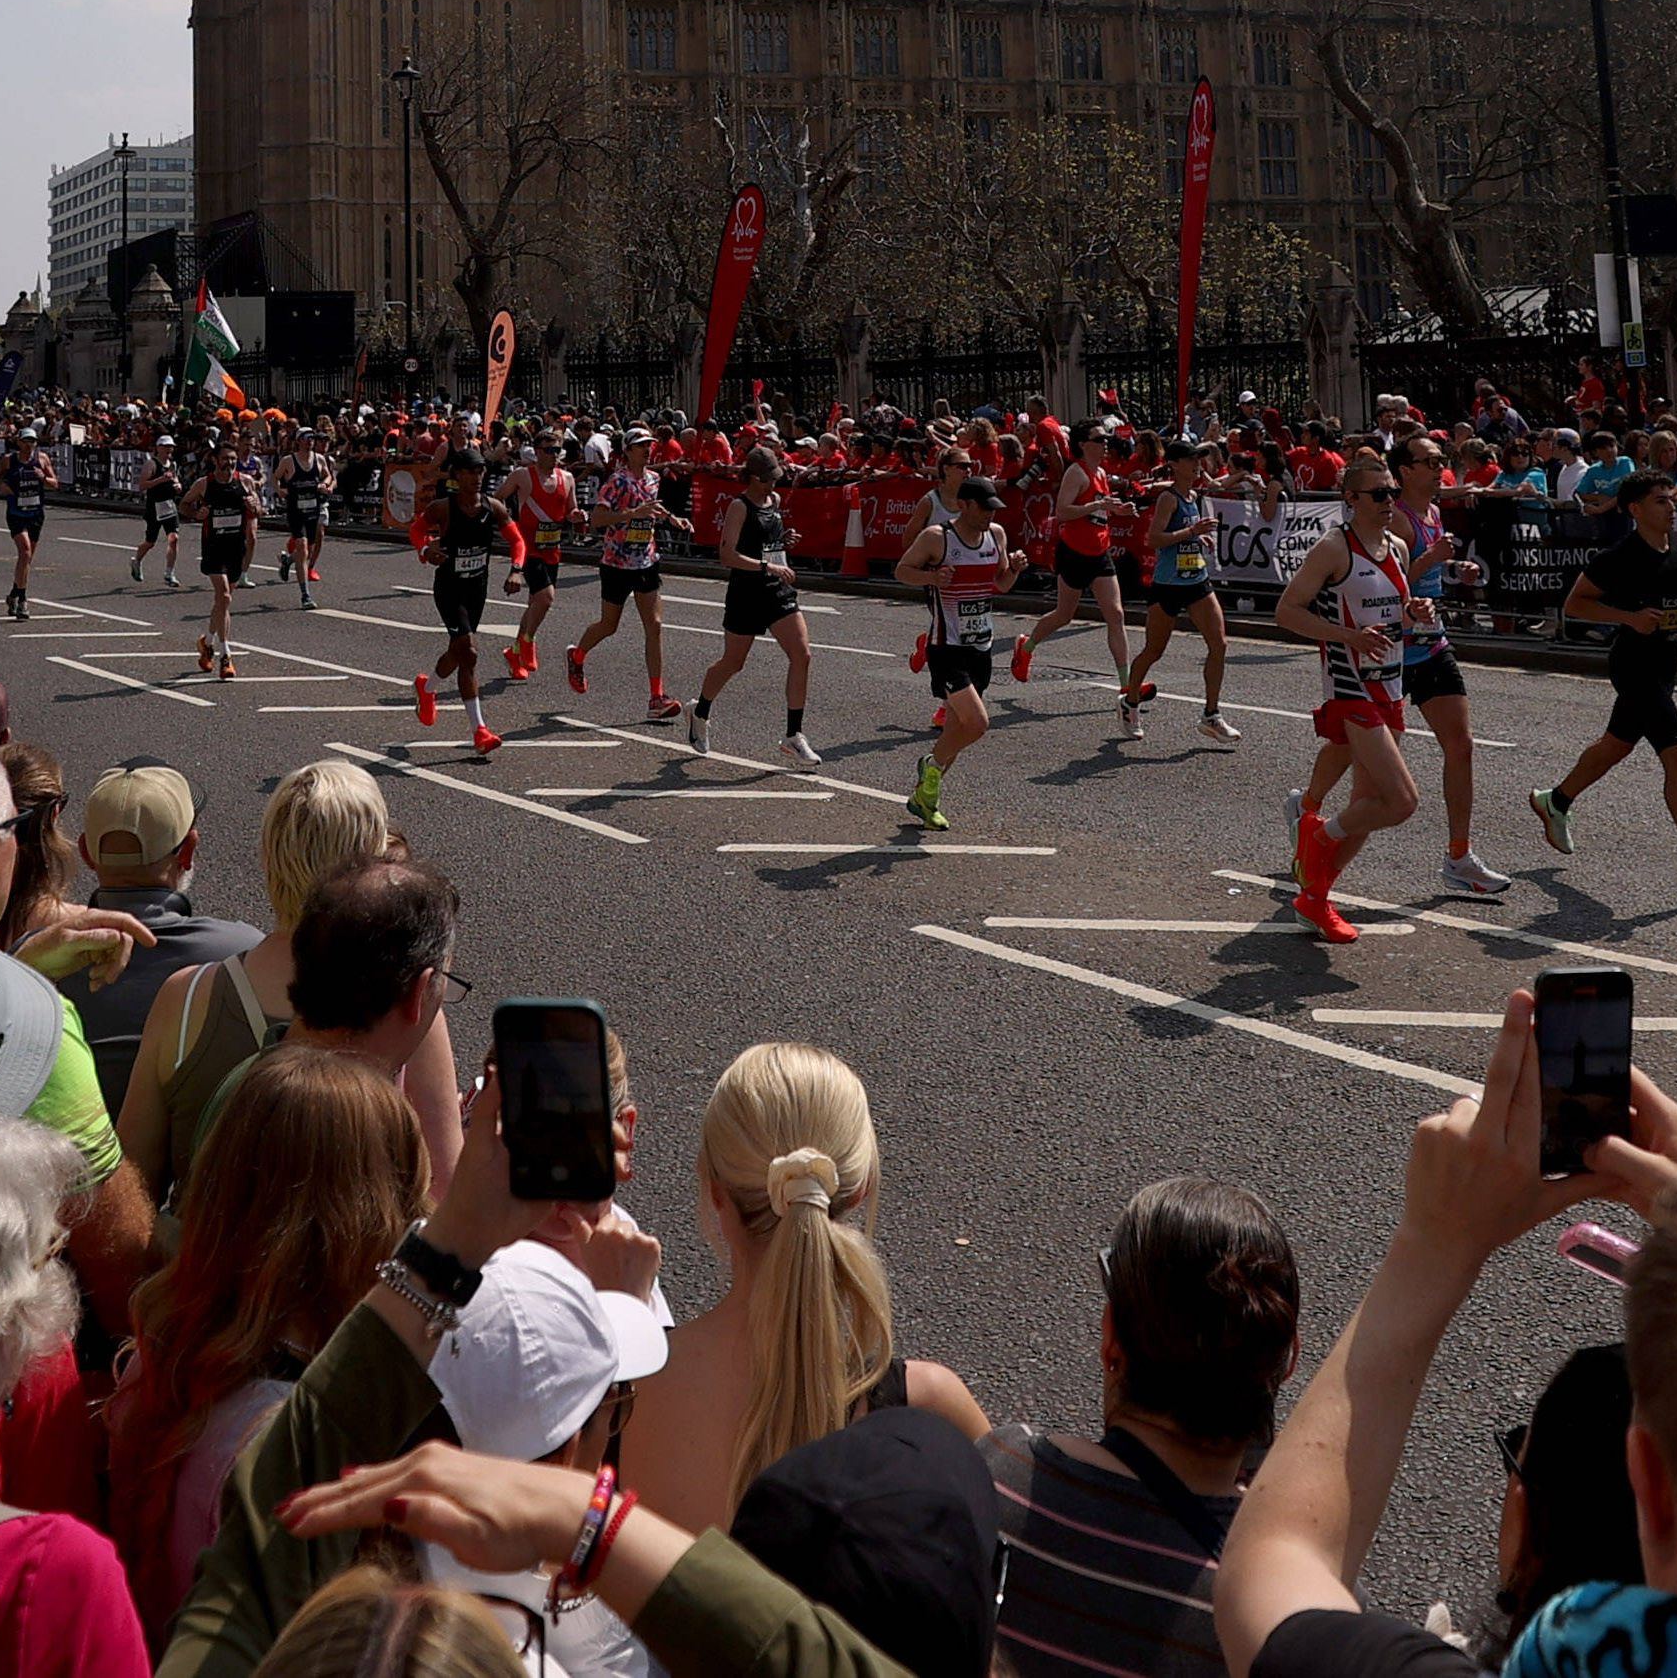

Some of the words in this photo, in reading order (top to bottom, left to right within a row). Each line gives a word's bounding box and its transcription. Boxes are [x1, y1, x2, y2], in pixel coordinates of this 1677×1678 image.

[406, 361, 417, 369] 20
[1285, 517, 1322, 531] TATA
[1510, 522, 1543, 541] ATA
[1218, 512, 1273, 568] tcs
[1277, 536, 1322, 551] CONS
[1499, 572, 1564, 592] SERVICES
